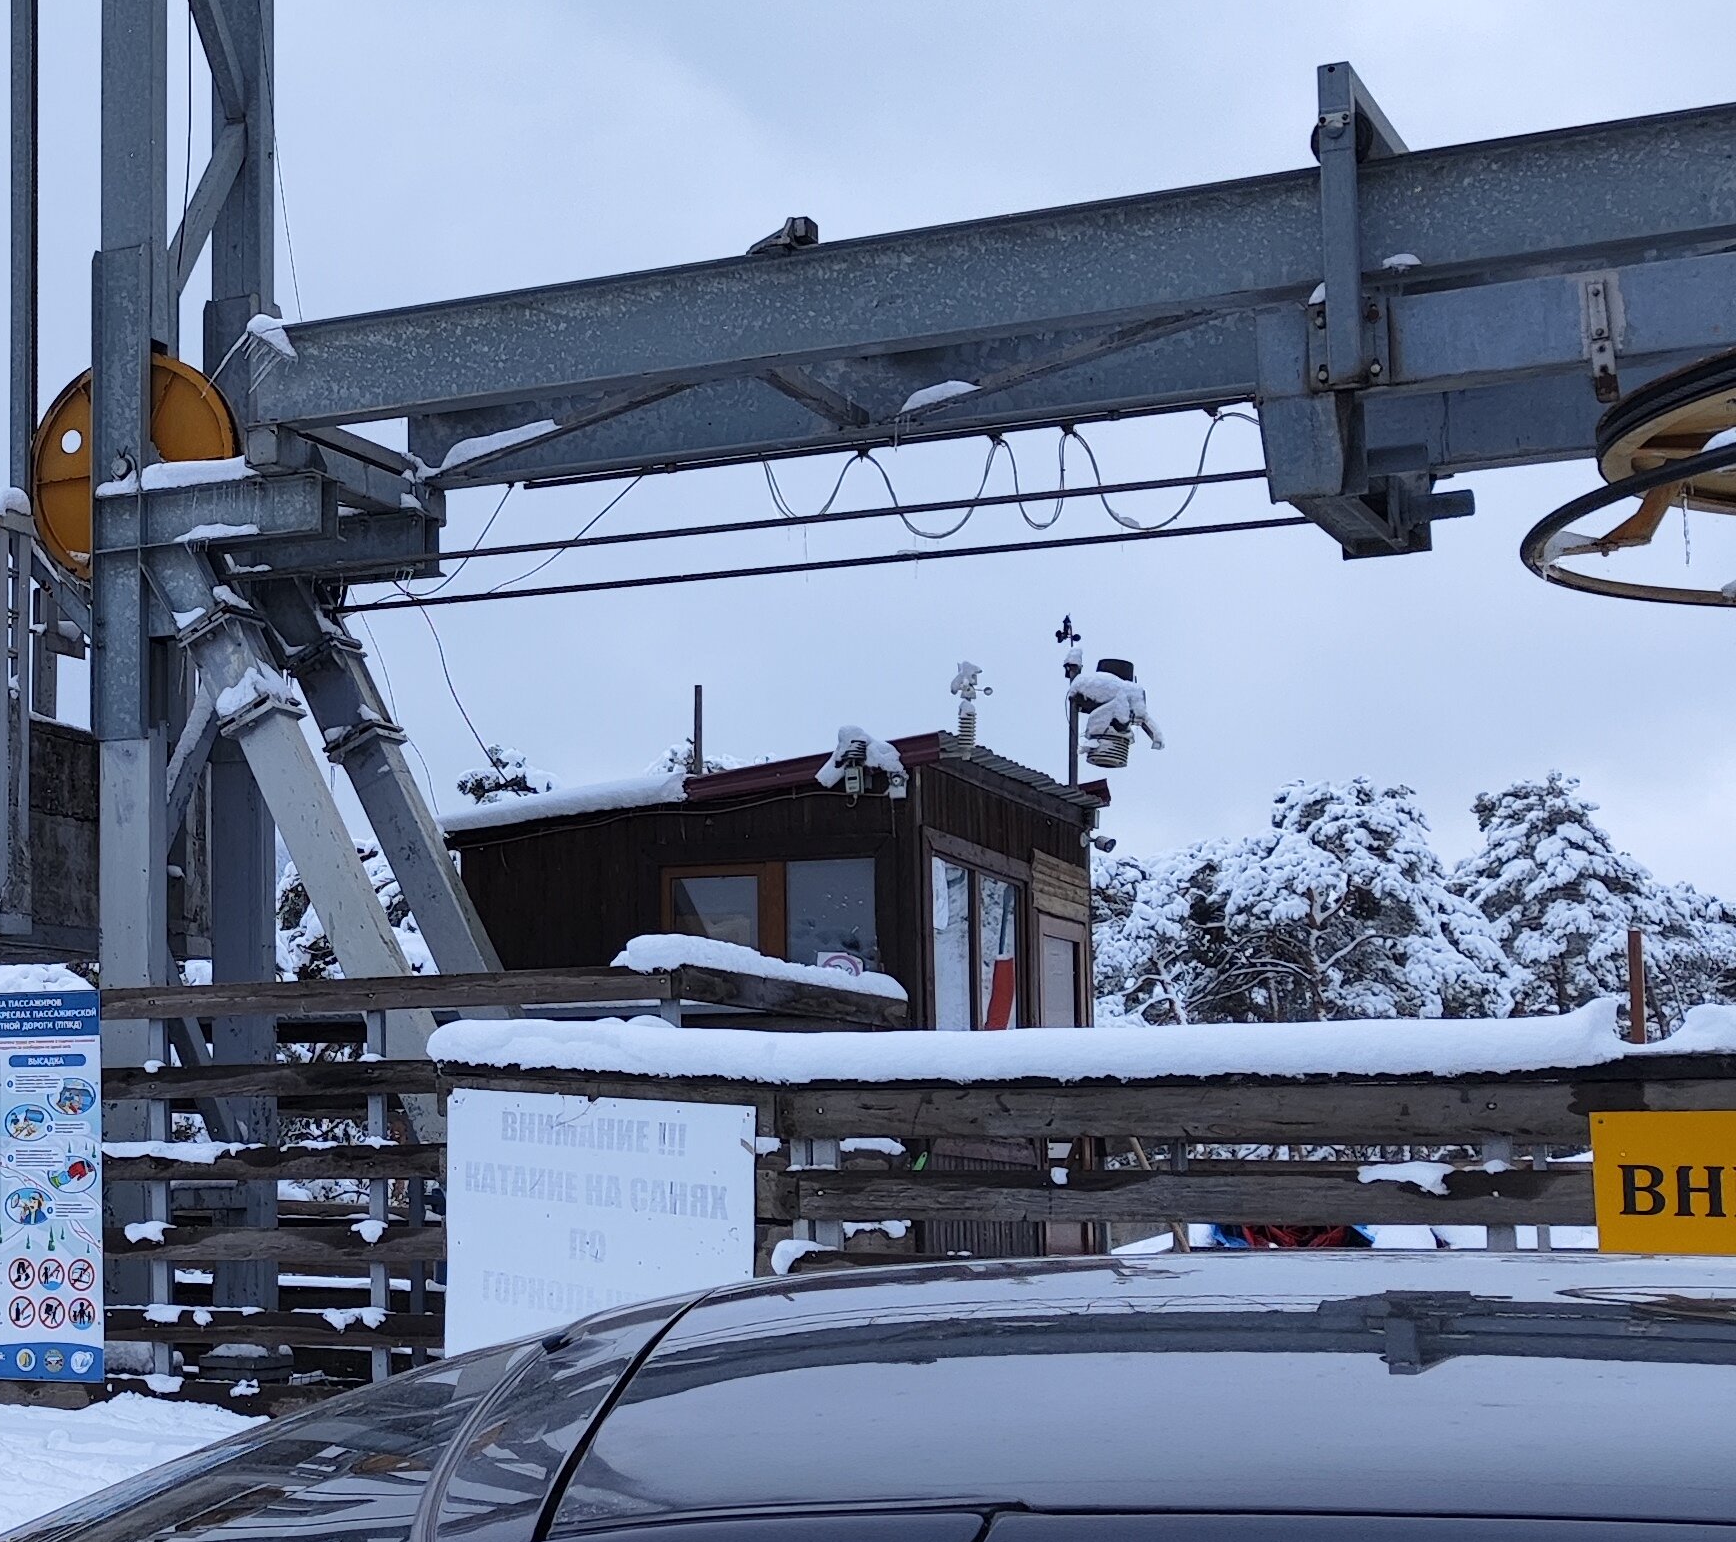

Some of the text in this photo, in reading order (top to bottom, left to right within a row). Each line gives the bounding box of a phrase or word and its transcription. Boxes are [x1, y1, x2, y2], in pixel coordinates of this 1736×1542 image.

[8, 999, 62, 1008] ПАССАЖИРОВ
[32, 1007, 96, 1019] ПАССАЖИРСКОЙ
[22, 1020, 53, 1031] ДОРОГИ
[55, 1020, 83, 1031] (ППКД)
[28, 1056, 65, 1067] ВЫСАДКА
[501, 1111, 687, 1157] ВНИМАНИЕ !!!
[585, 1173, 623, 1209] НА
[630, 1177, 729, 1221] САНЯХ
[1617, 1164, 1736, 1217] ВН
[569, 1227, 607, 1263] ПО
[482, 1269, 648, 1315] ГОРНОЛЫ
